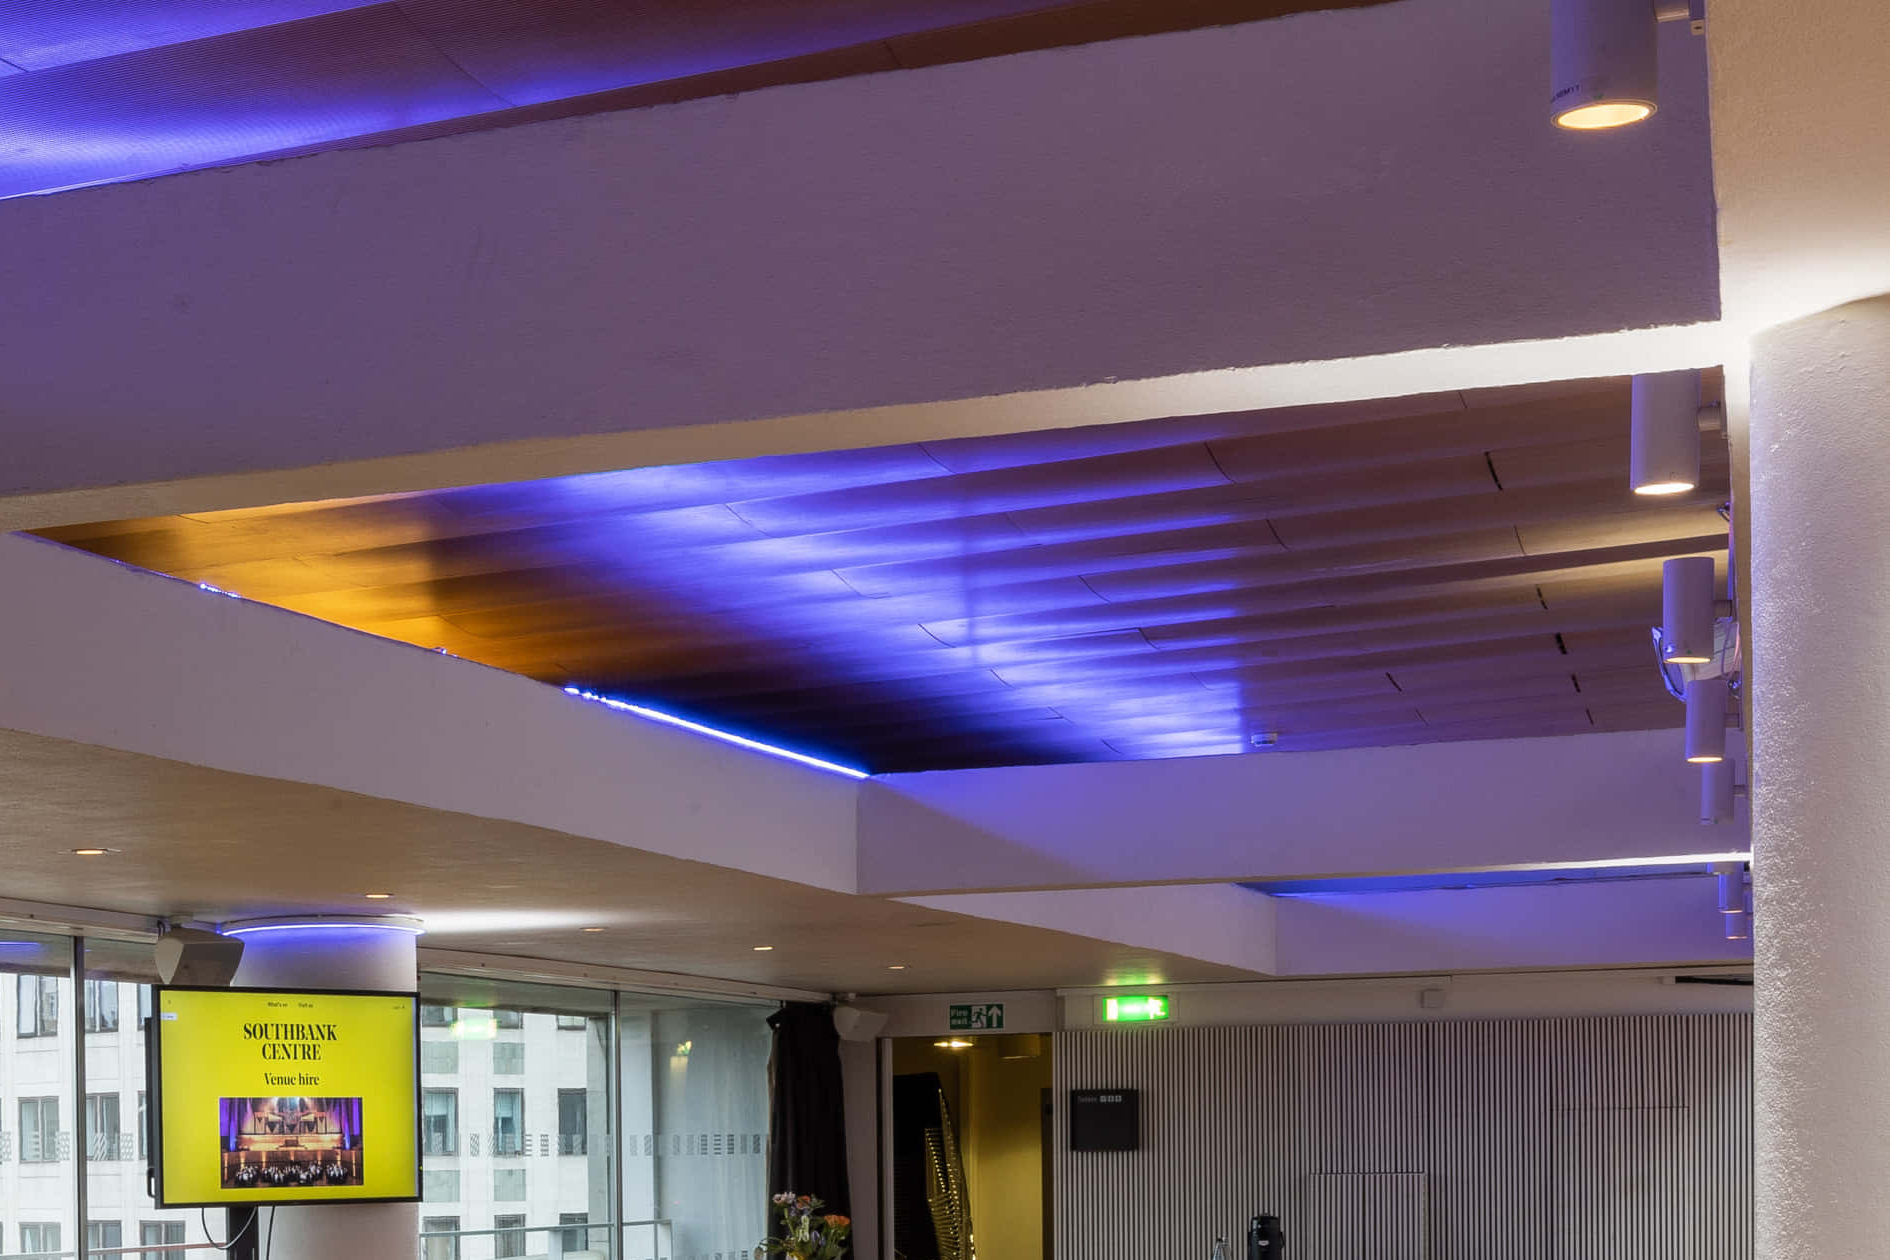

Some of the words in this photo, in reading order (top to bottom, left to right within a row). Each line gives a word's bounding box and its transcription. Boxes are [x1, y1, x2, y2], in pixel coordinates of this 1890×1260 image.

[950, 1008, 968, 1017] Fire
[243, 1023, 338, 1040] SOUTHBANK
[262, 1043, 321, 1060] CENTRE
[264, 1072, 296, 1086] Venue
[298, 1072, 320, 1086] hire
